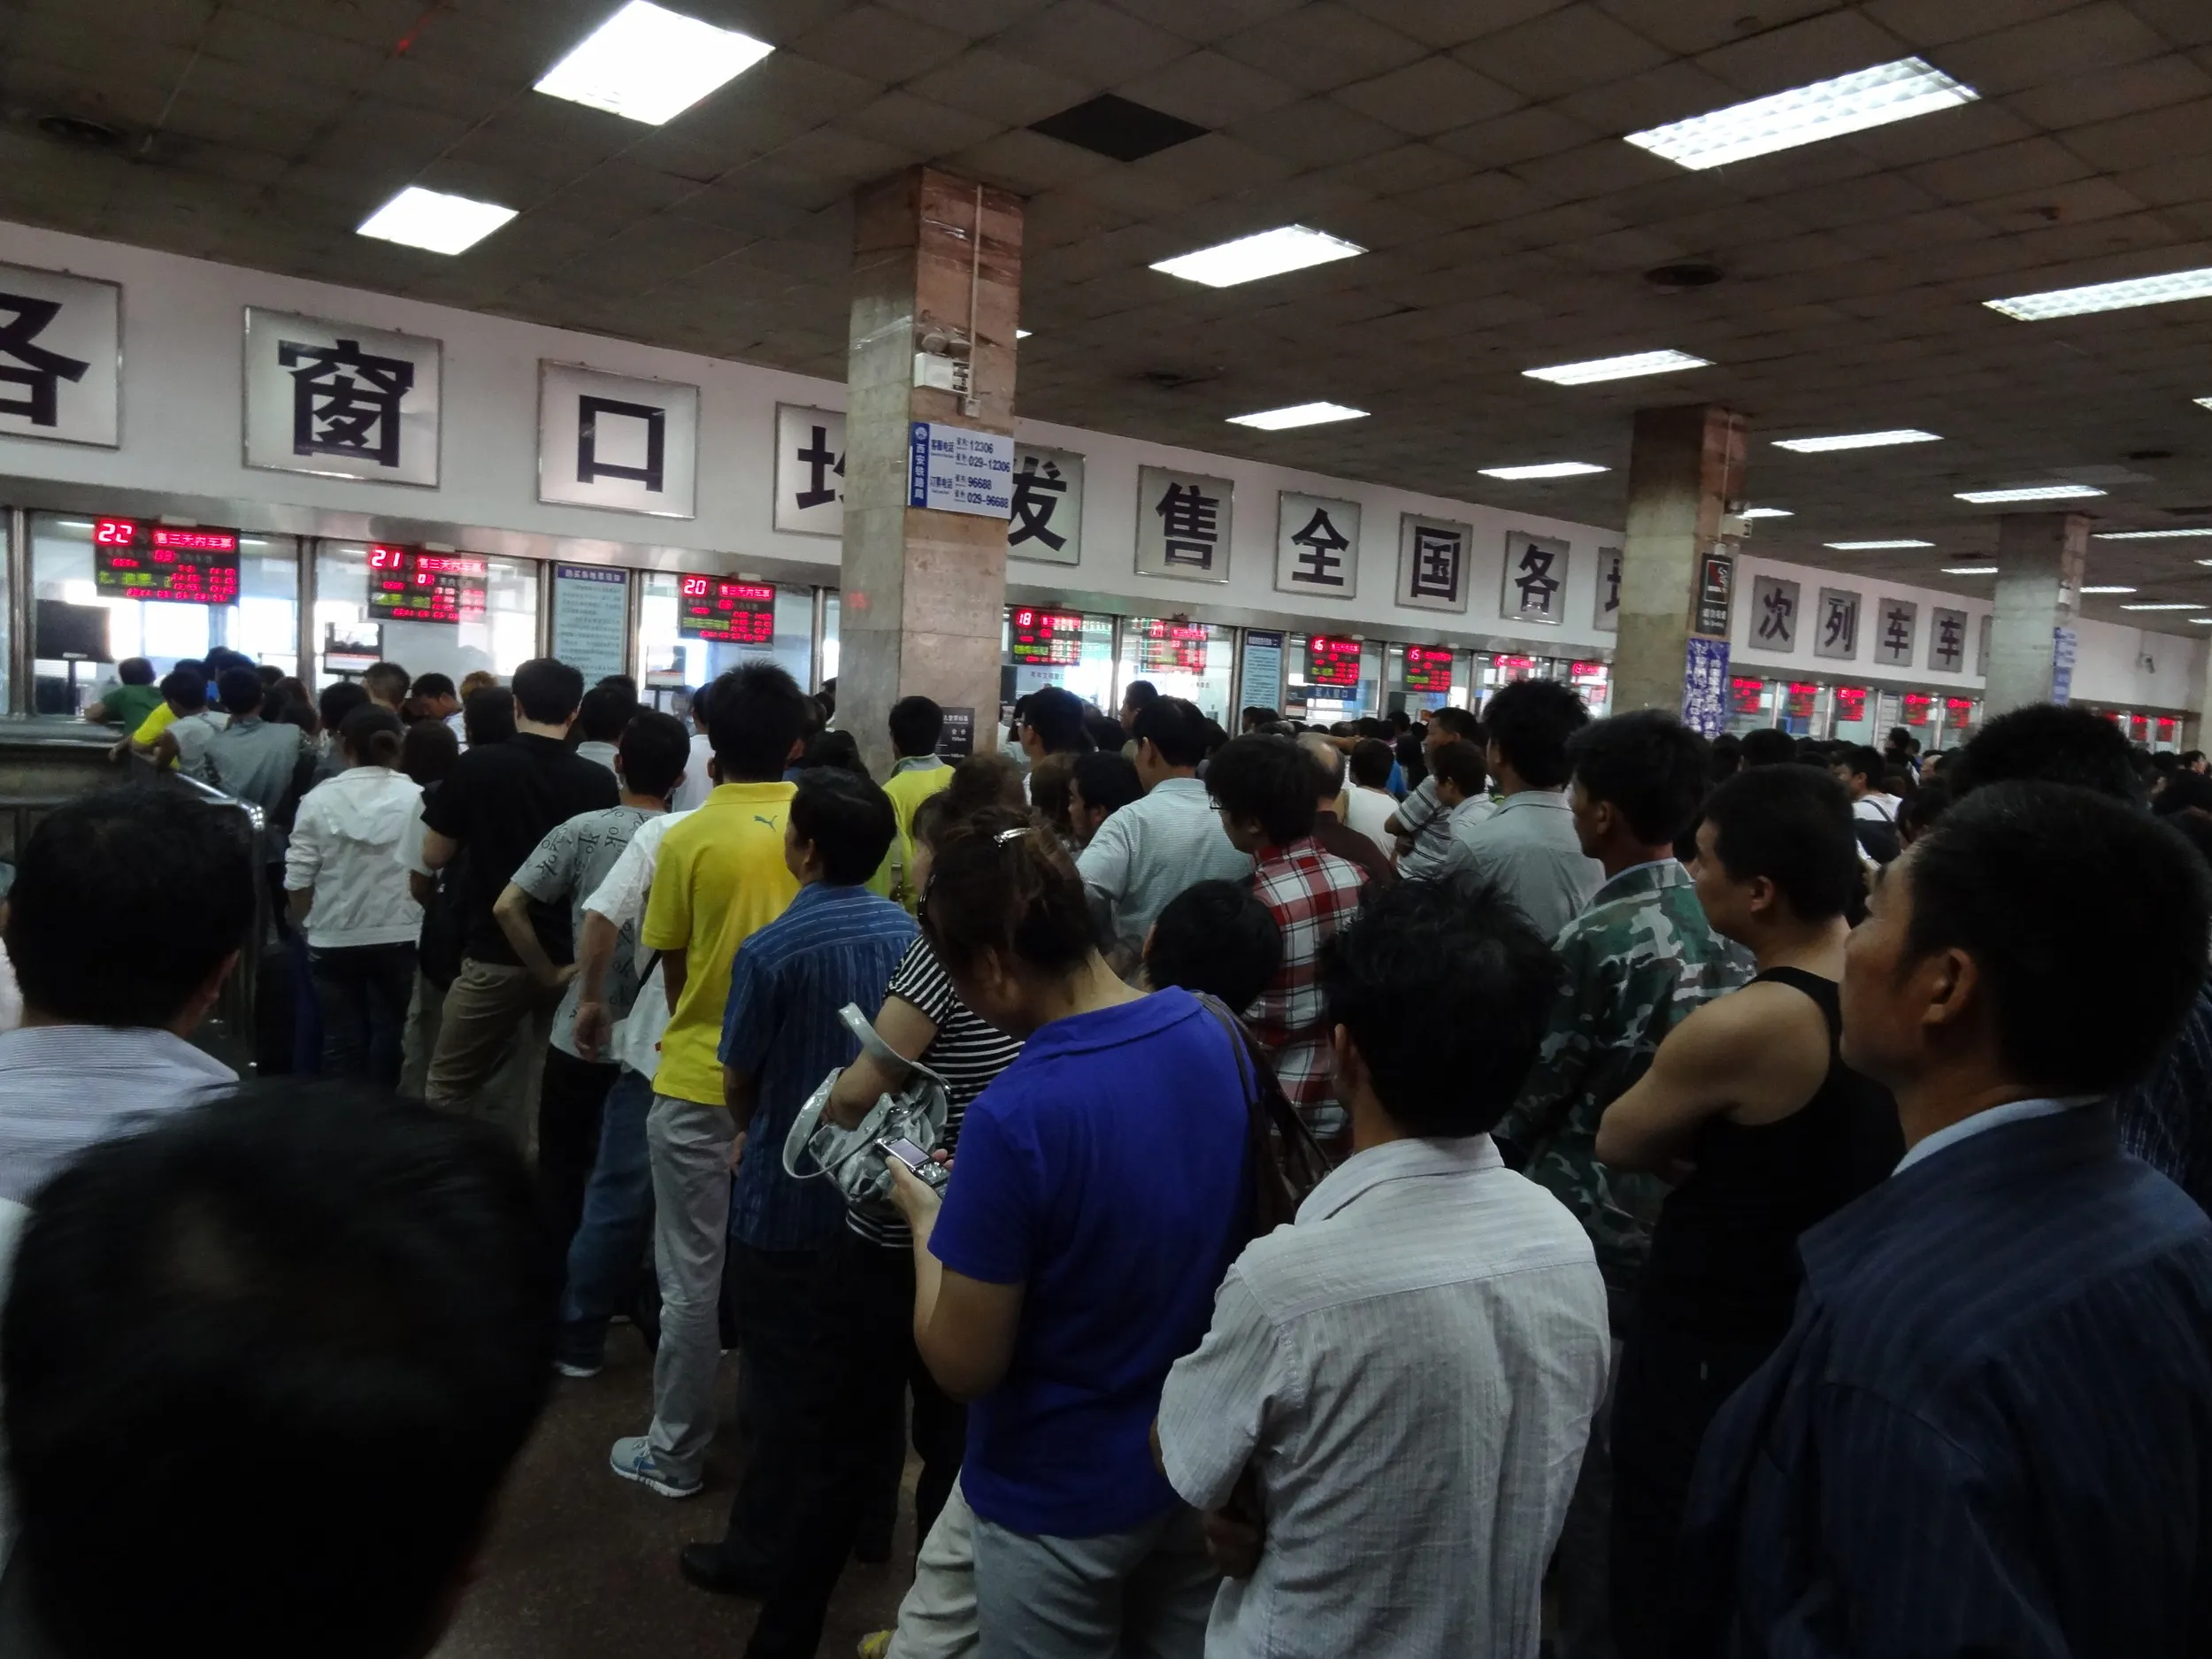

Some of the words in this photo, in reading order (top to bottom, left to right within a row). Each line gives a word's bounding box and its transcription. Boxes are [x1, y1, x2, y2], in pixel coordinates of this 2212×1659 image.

[970, 441, 994, 454] 12306
[914, 443, 926, 499] 西安铁路局
[968, 456, 1010, 472] 029-12306
[279, 339, 414, 467] 窗
[577, 395, 665, 492] 口
[1156, 482, 1220, 571] 售
[1291, 508, 1349, 586] 全
[1411, 526, 1461, 602] 国
[1515, 543, 1559, 614] 各
[1759, 588, 1793, 641] 次
[1825, 597, 1855, 652] 列
[1884, 608, 1911, 658] 车
[1937, 617, 1962, 664] 车
[98, 523, 133, 543] 22
[153, 532, 234, 549] 售三天内车票
[371, 549, 400, 567] 21
[684, 580, 707, 595] 20
[1019, 612, 1032, 626] 18
